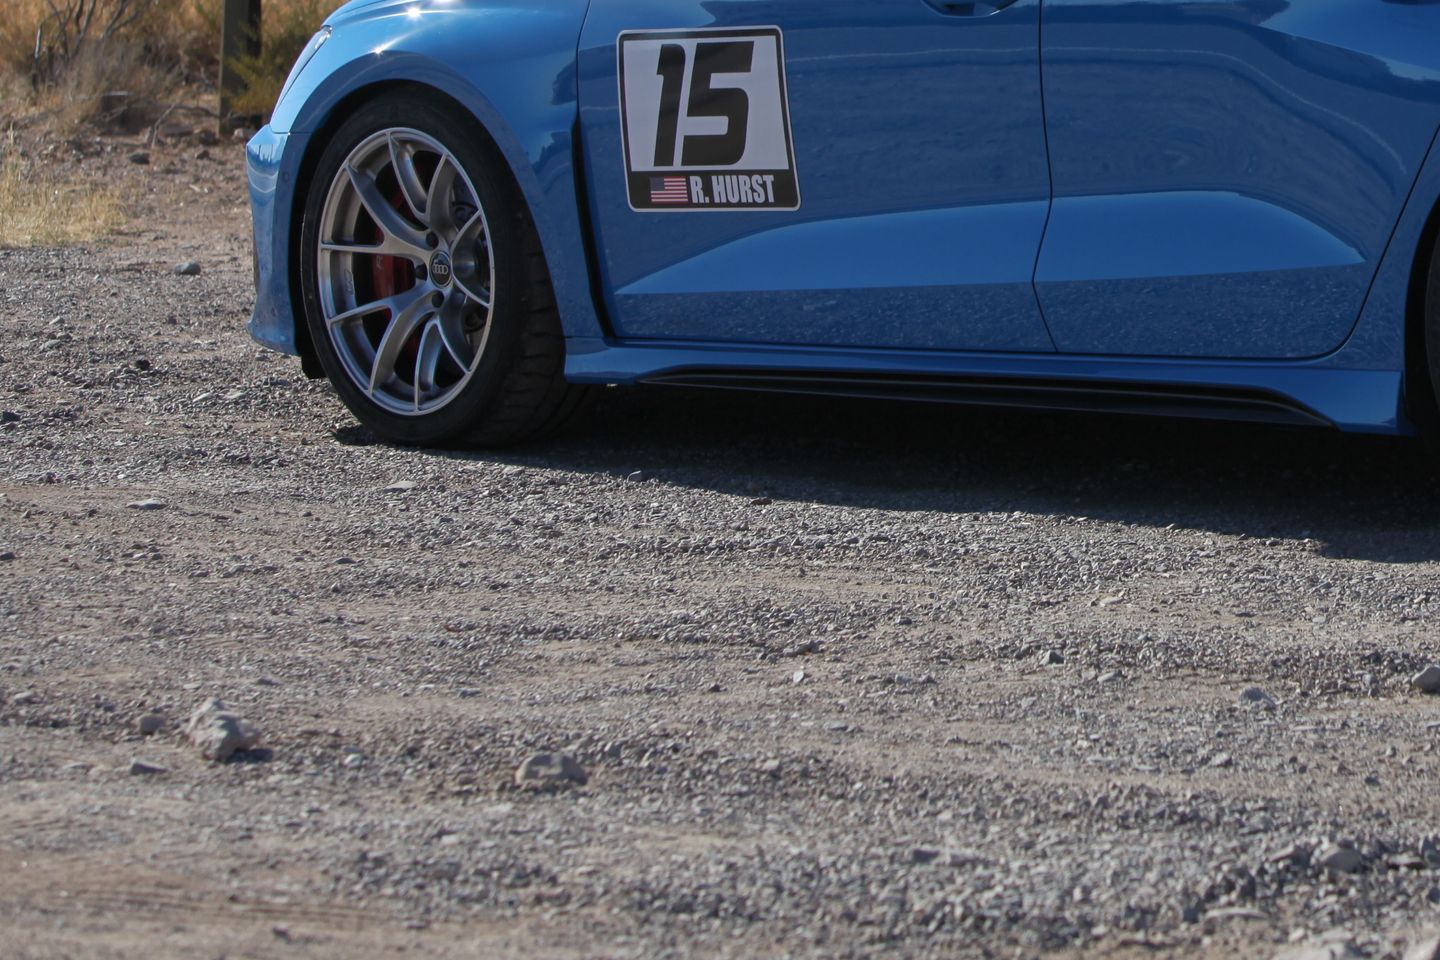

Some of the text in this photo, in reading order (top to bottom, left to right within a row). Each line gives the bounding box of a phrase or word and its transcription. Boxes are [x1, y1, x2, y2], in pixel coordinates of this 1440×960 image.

[653, 40, 755, 168] 15
[689, 174, 776, 204] R. HURST
